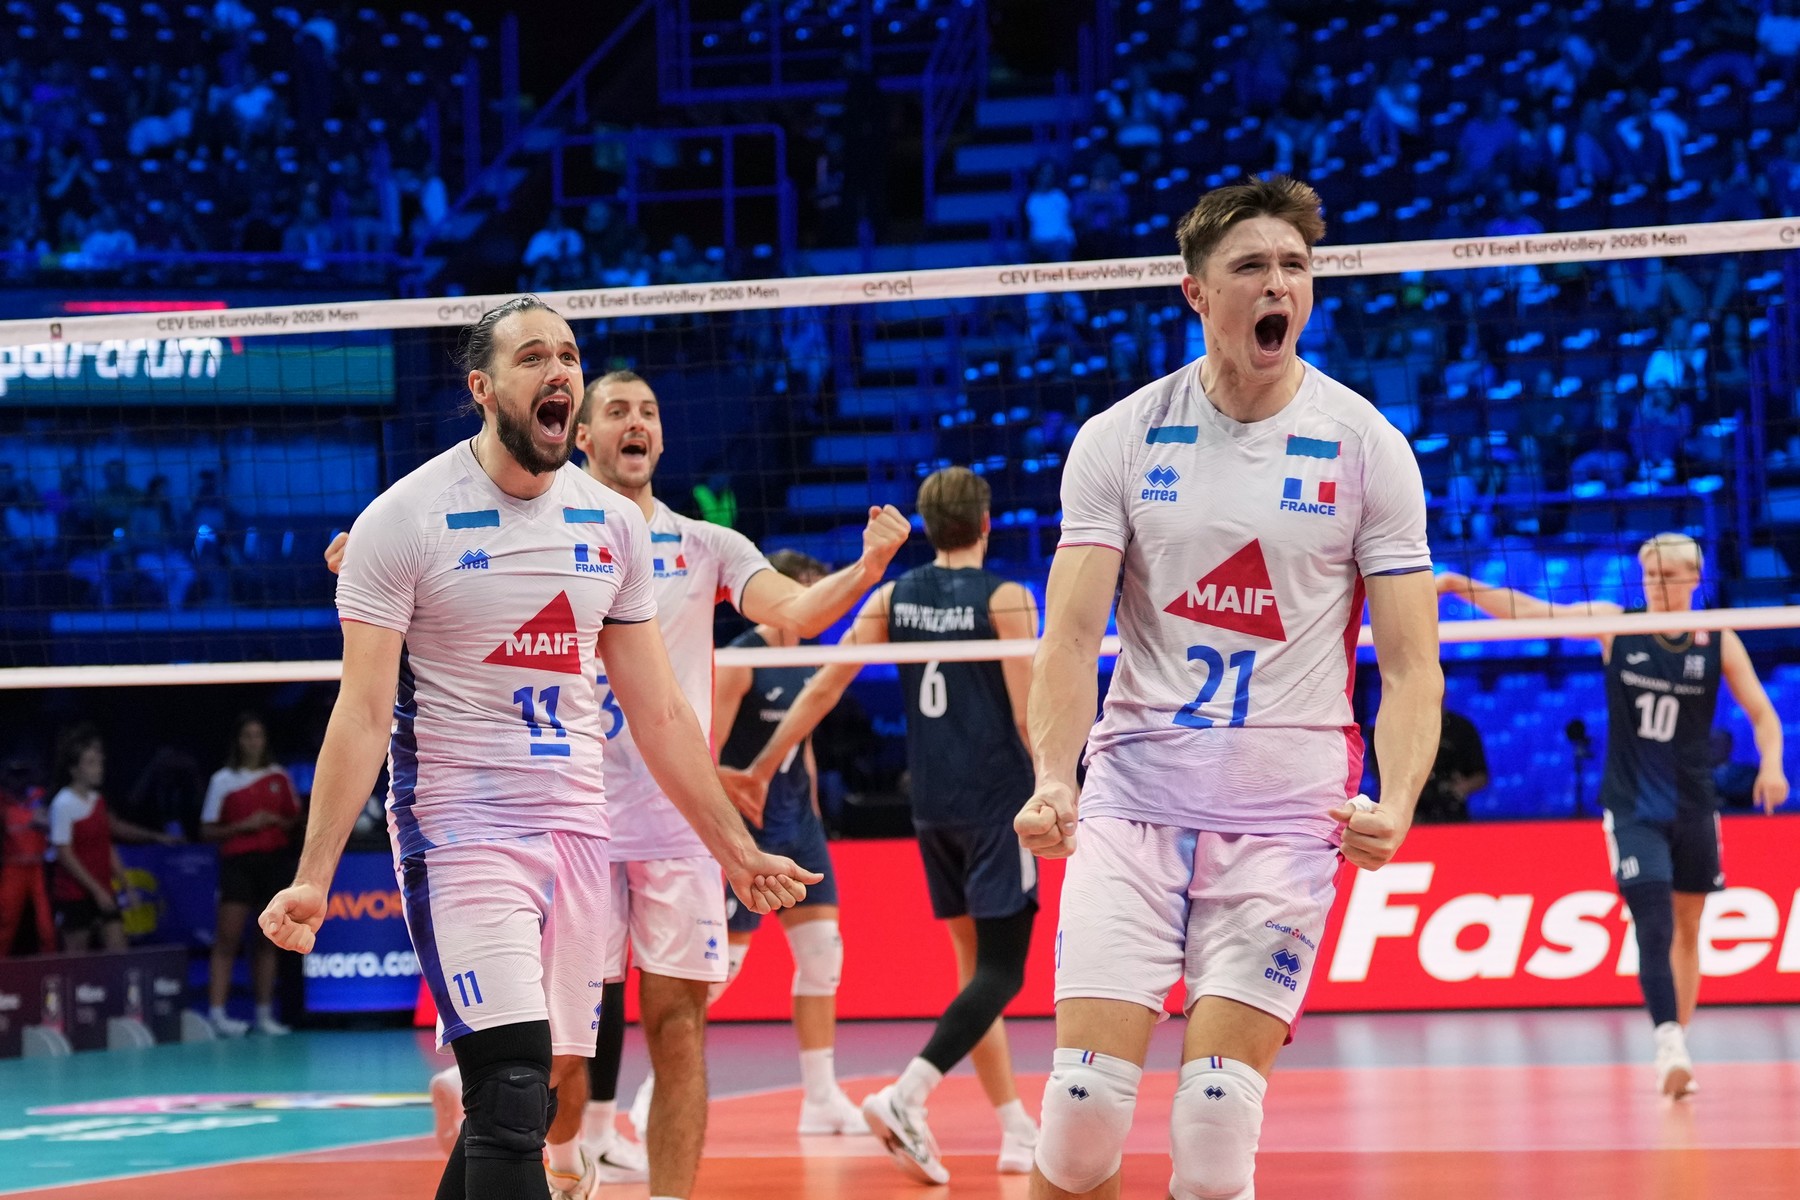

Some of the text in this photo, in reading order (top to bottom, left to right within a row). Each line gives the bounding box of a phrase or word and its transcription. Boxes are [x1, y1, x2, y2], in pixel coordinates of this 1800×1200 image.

[1453, 232, 1687, 259] CEV Enel EuroVolley 2026 Men
[1311, 250, 1362, 271] enel
[1000, 262, 1184, 285] CEV Enel EuroVolley 2026
[567, 285, 779, 310] CEV Enel EuroVolley 2026 Men
[863, 276, 913, 297] enel
[157, 307, 359, 331] CEV Enel EuroVolley 2026 Men
[1141, 487, 1178, 502] errea
[1280, 500, 1336, 516] FRANCE
[575, 563, 614, 574] FRANCE
[1187, 583, 1275, 616] MAIF
[505, 632, 578, 656] MAIF
[919, 660, 947, 718] 6
[1172, 645, 1256, 728] 21
[513, 686, 567, 738] 11
[1635, 692, 1680, 742] 10
[1264, 920, 1291, 934] Crédit
[453, 970, 483, 1007] 11
[1264, 967, 1297, 992] errea
